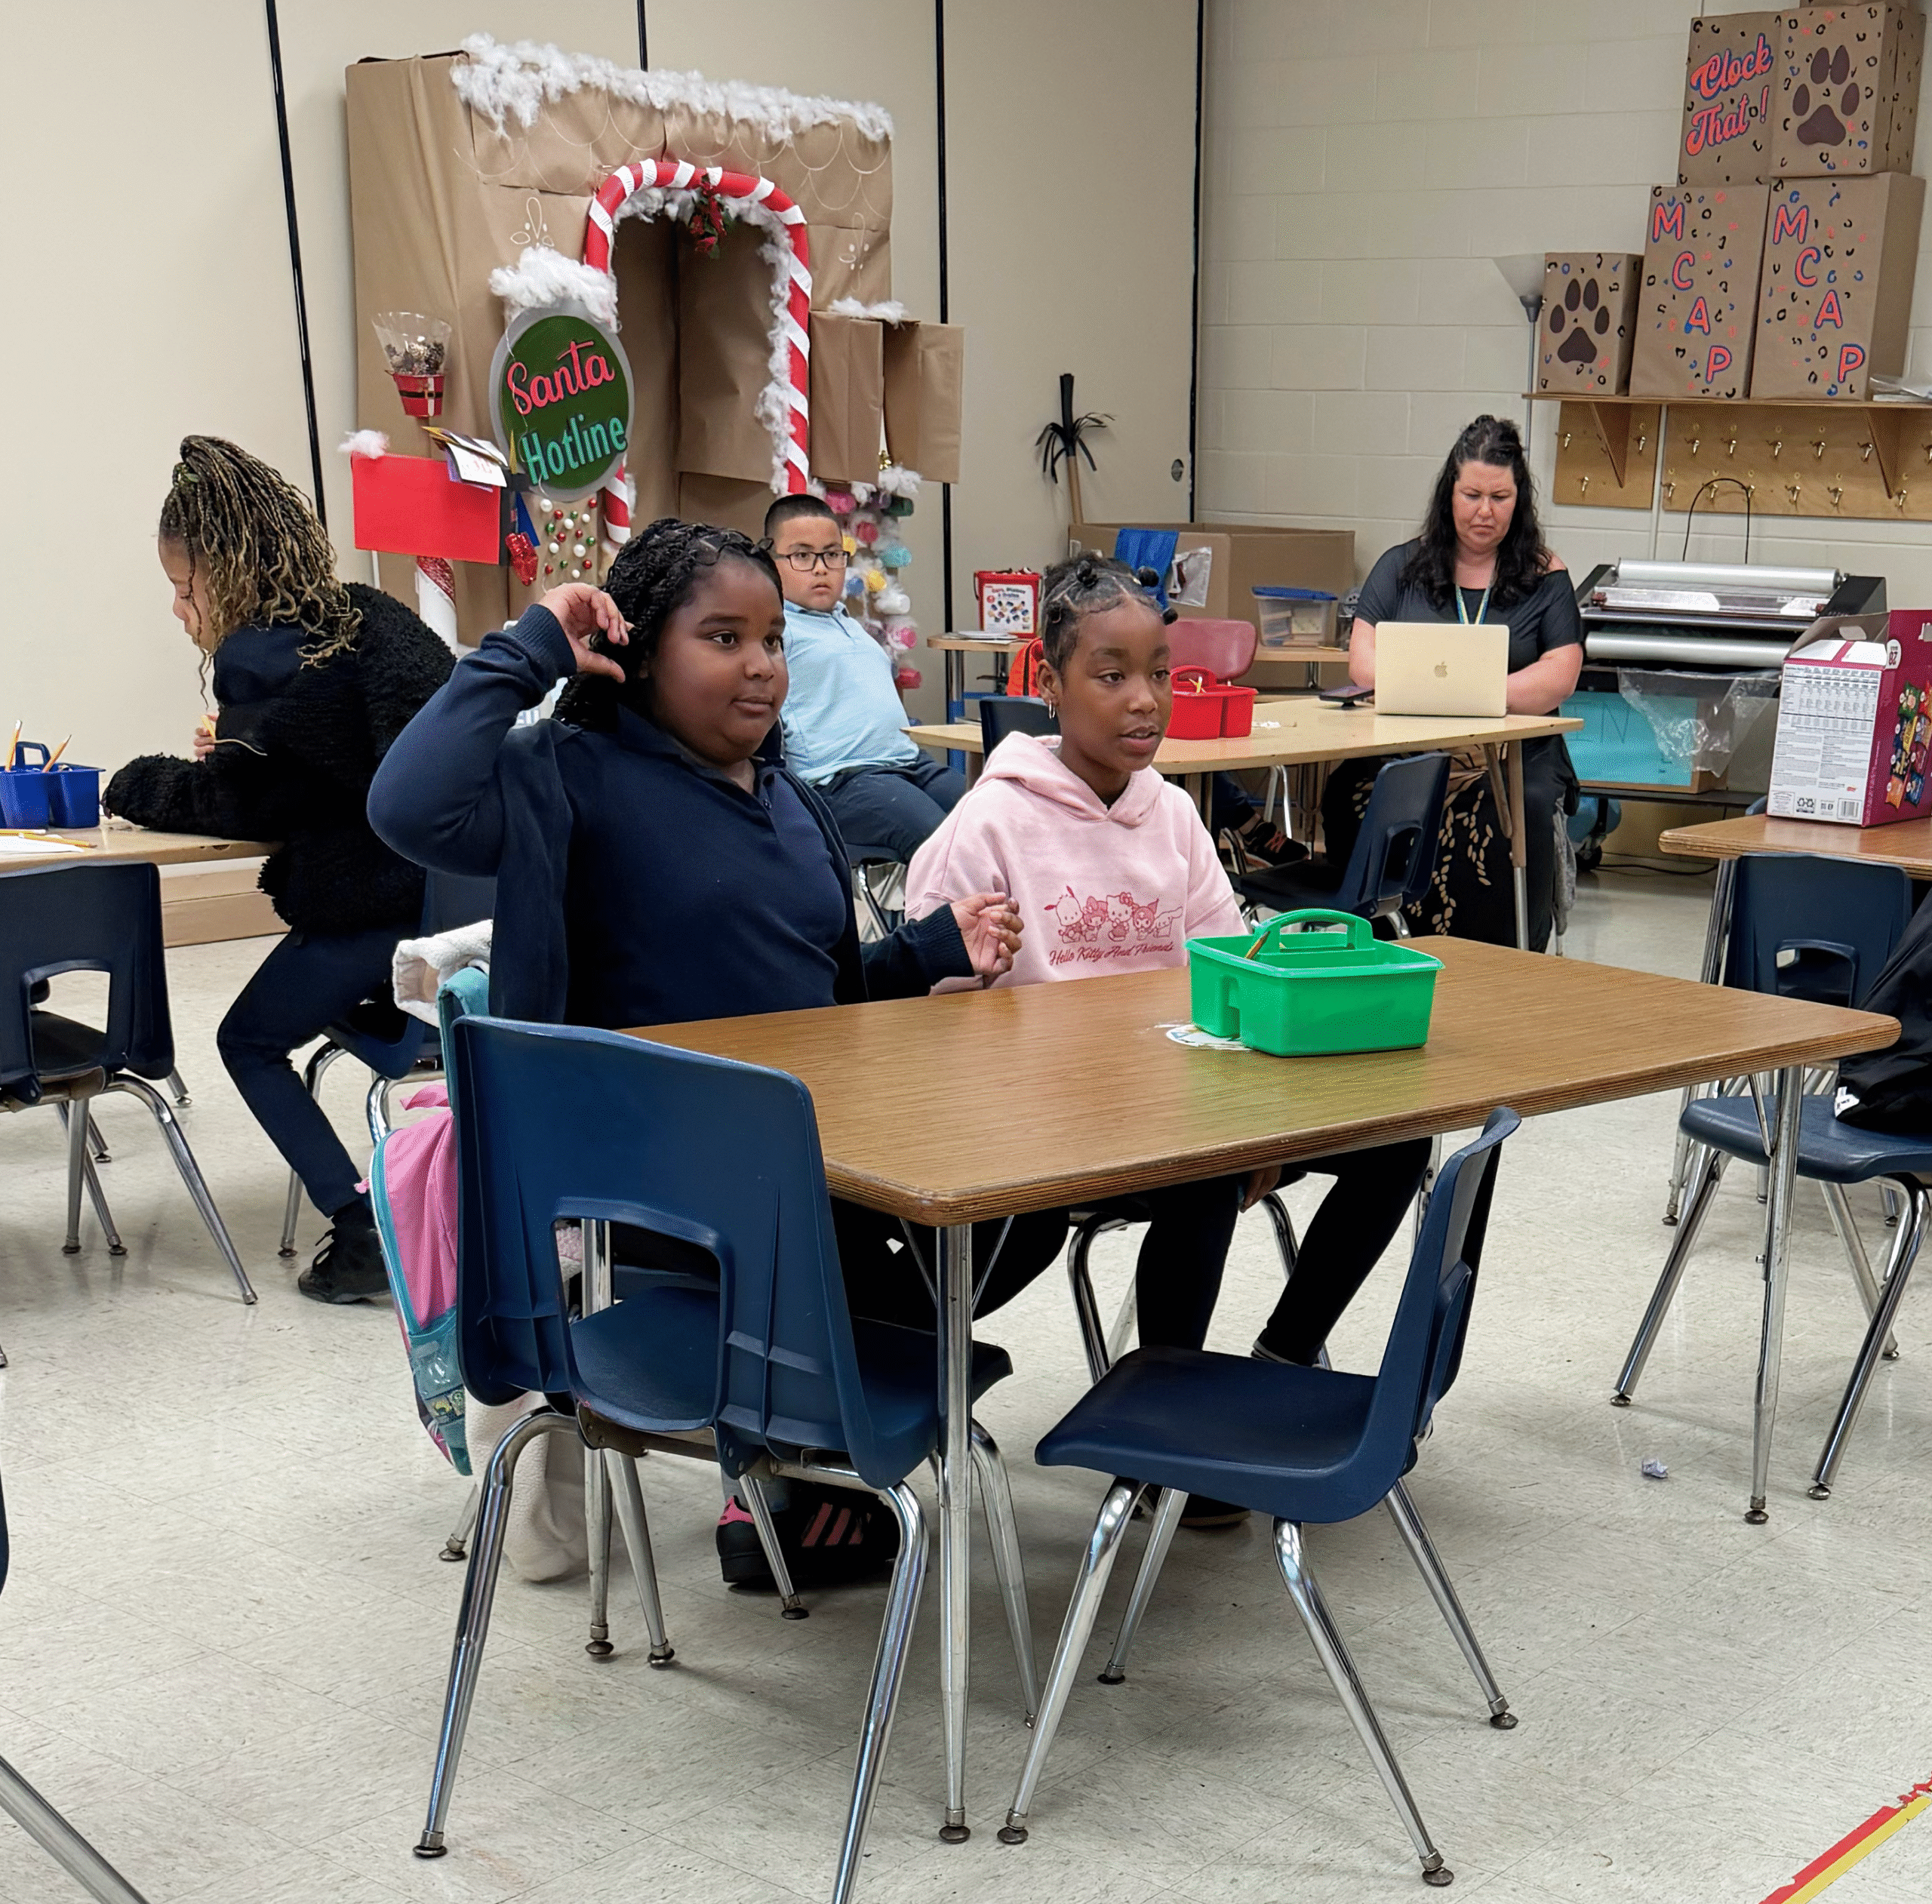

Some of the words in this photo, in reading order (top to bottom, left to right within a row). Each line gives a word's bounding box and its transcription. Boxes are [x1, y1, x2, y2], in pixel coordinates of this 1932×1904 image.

[1690, 33, 1773, 100] Clock
[506, 341, 615, 415] Santa
[520, 414, 629, 485] Hotline
[1050, 949, 1075, 966] Hello
[1077, 946, 1104, 963] Kitty
